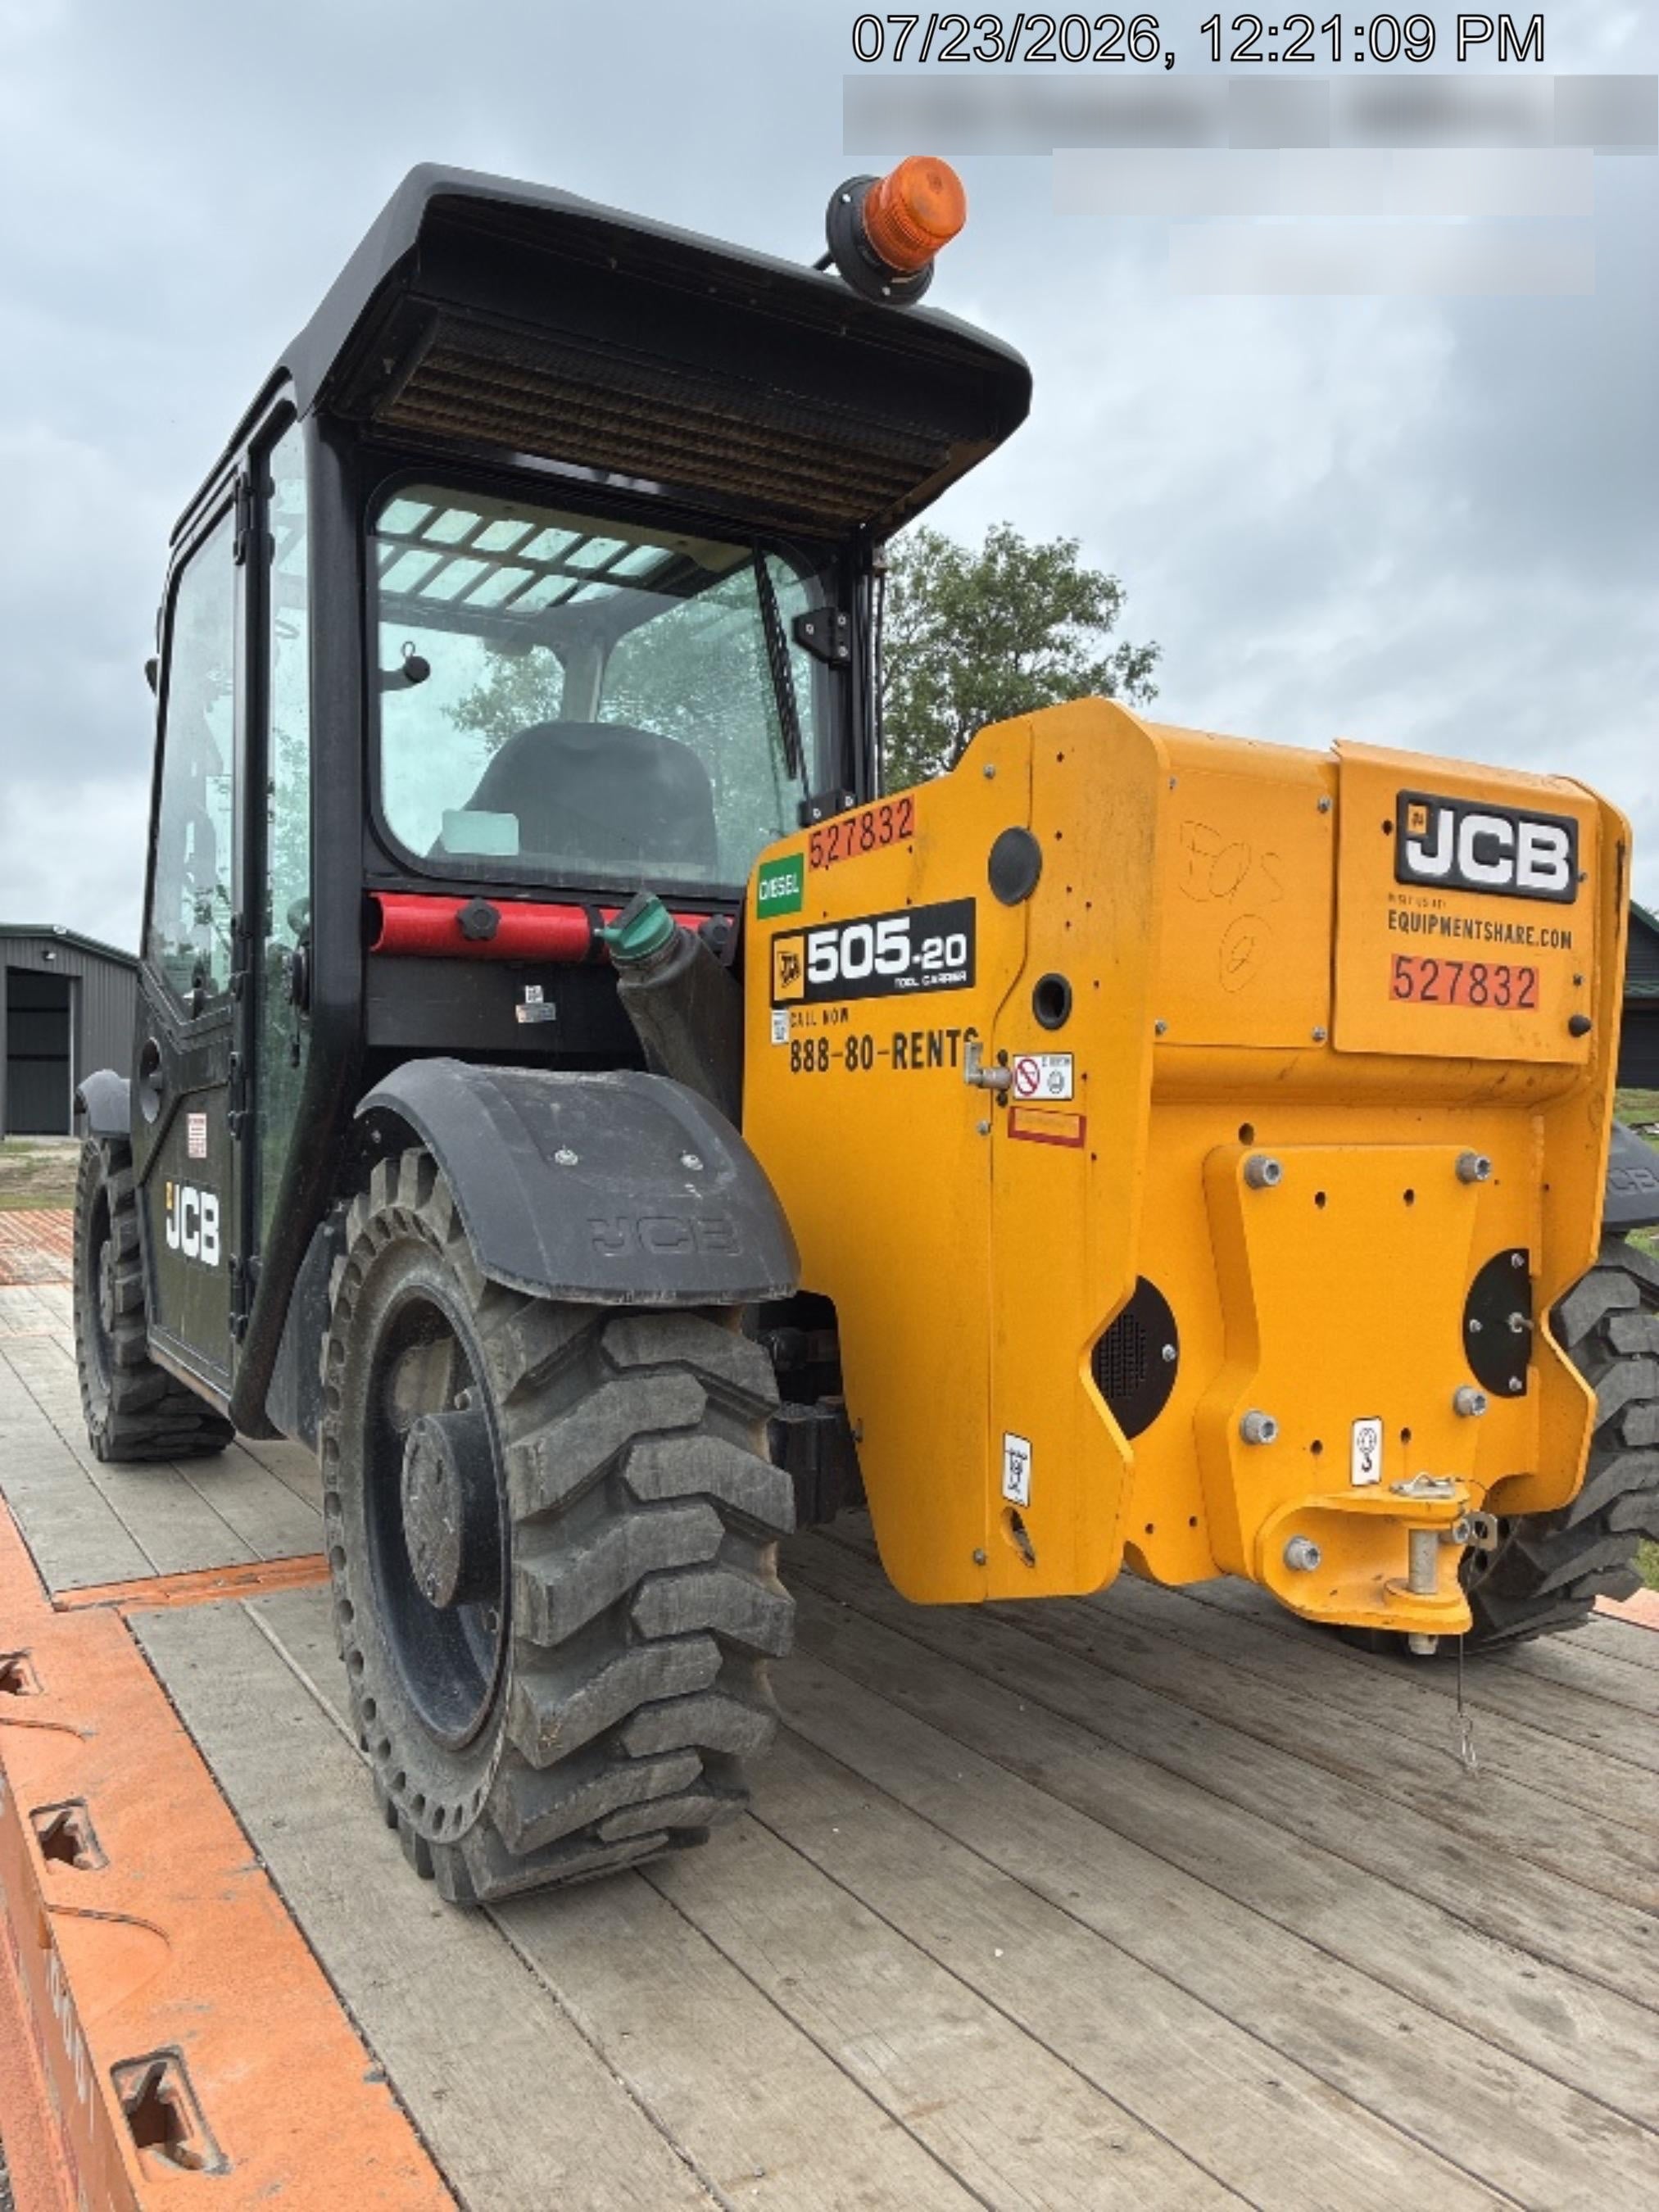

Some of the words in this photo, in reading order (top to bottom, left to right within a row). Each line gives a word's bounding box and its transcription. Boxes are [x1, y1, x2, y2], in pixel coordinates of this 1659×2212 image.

[809, 798, 914, 868] 527832
[1406, 808, 1571, 891] JCB
[759, 873, 800, 901] DIESEL
[1388, 909, 1572, 950] EQUIPMENTSHARE.COM
[1394, 955, 1535, 1009] 527832
[791, 1009, 817, 1028] CALL
[823, 1007, 849, 1026] NOW
[165, 1184, 220, 1267] JCB
[587, 1216, 743, 1257] JCB
